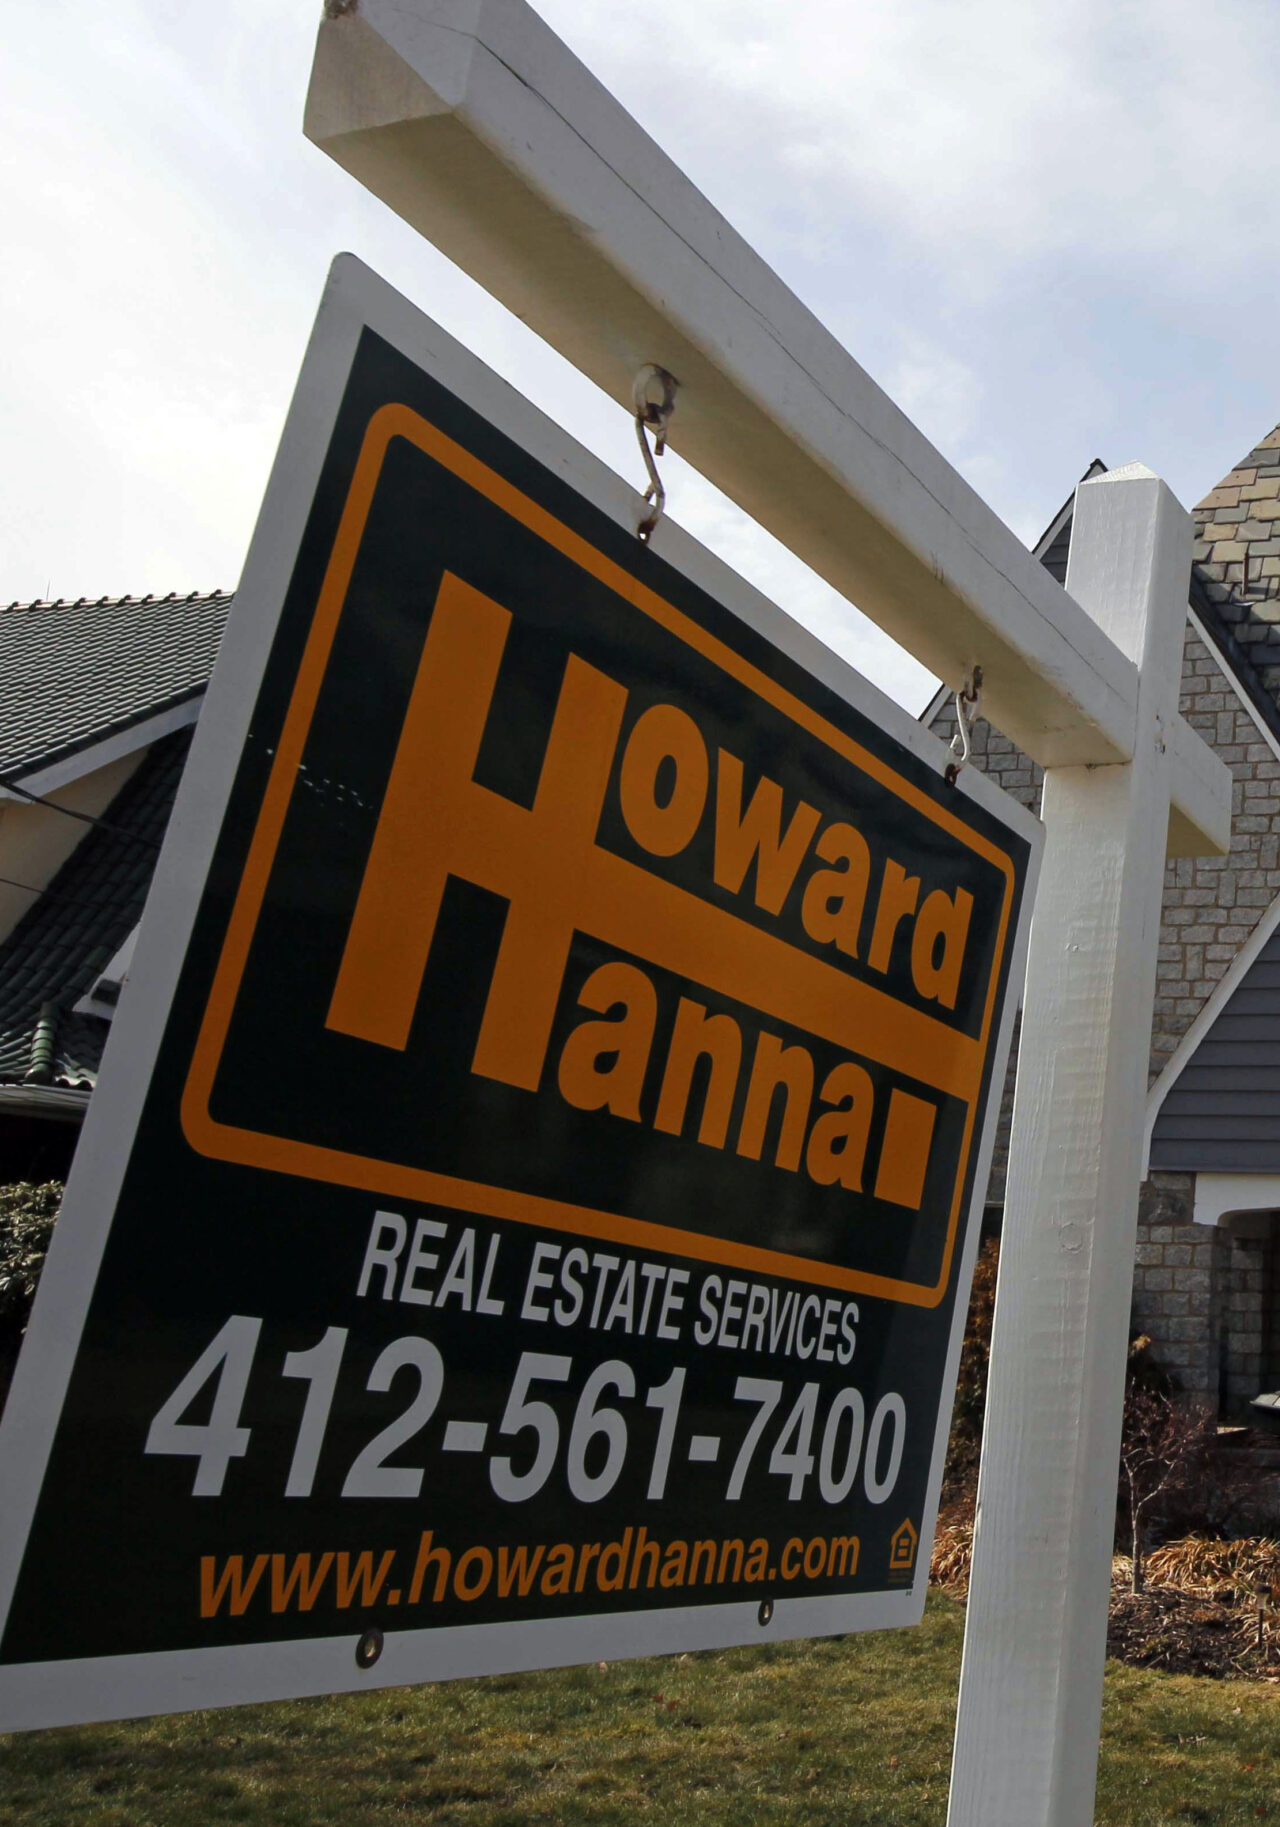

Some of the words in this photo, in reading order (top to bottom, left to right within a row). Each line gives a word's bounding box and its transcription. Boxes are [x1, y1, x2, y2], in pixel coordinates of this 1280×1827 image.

[340, 569, 975, 1010] Howard
[325, 770, 876, 1193] Hanna
[356, 1210, 505, 1316] REAL
[520, 1241, 691, 1340] ESTATE
[694, 1274, 859, 1365] SERVICES
[144, 1314, 907, 1505] 412-561-7400
[199, 1526, 861, 1619] www.howardhanna.com
